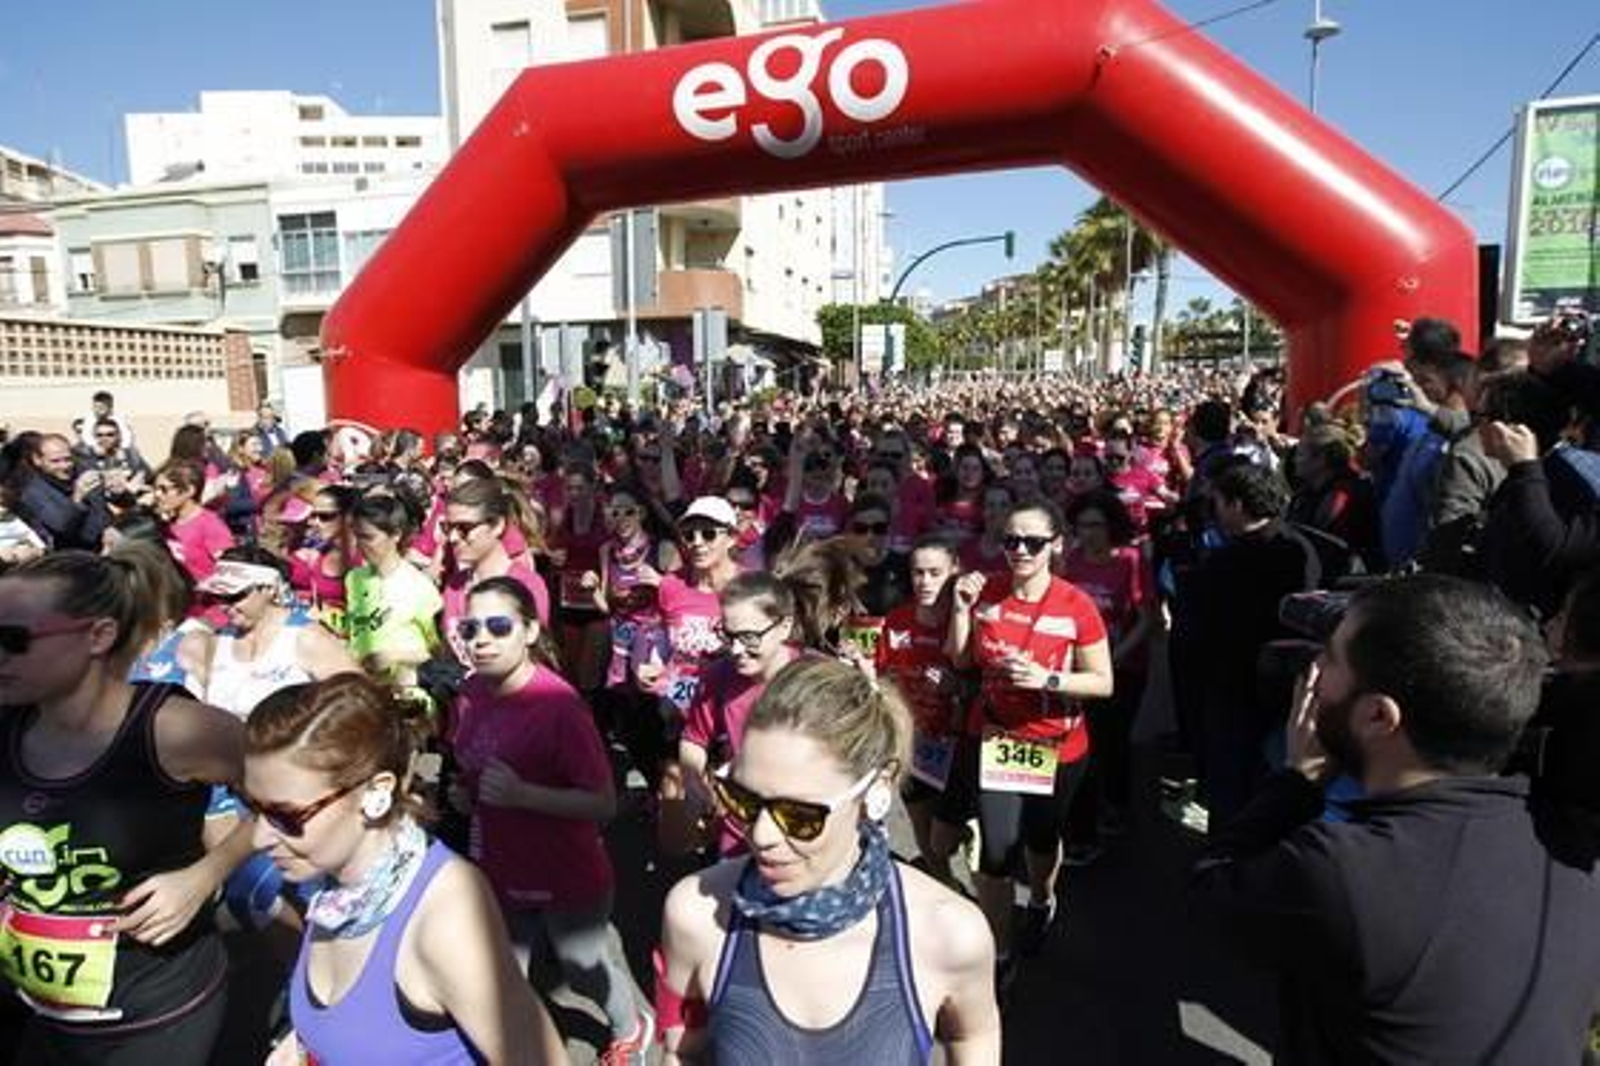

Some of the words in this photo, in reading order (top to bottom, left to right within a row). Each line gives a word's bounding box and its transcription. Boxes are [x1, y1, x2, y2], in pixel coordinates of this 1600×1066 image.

[673, 27, 909, 159] ego
[996, 743, 1043, 768] 346
[11, 945, 86, 986] 167
